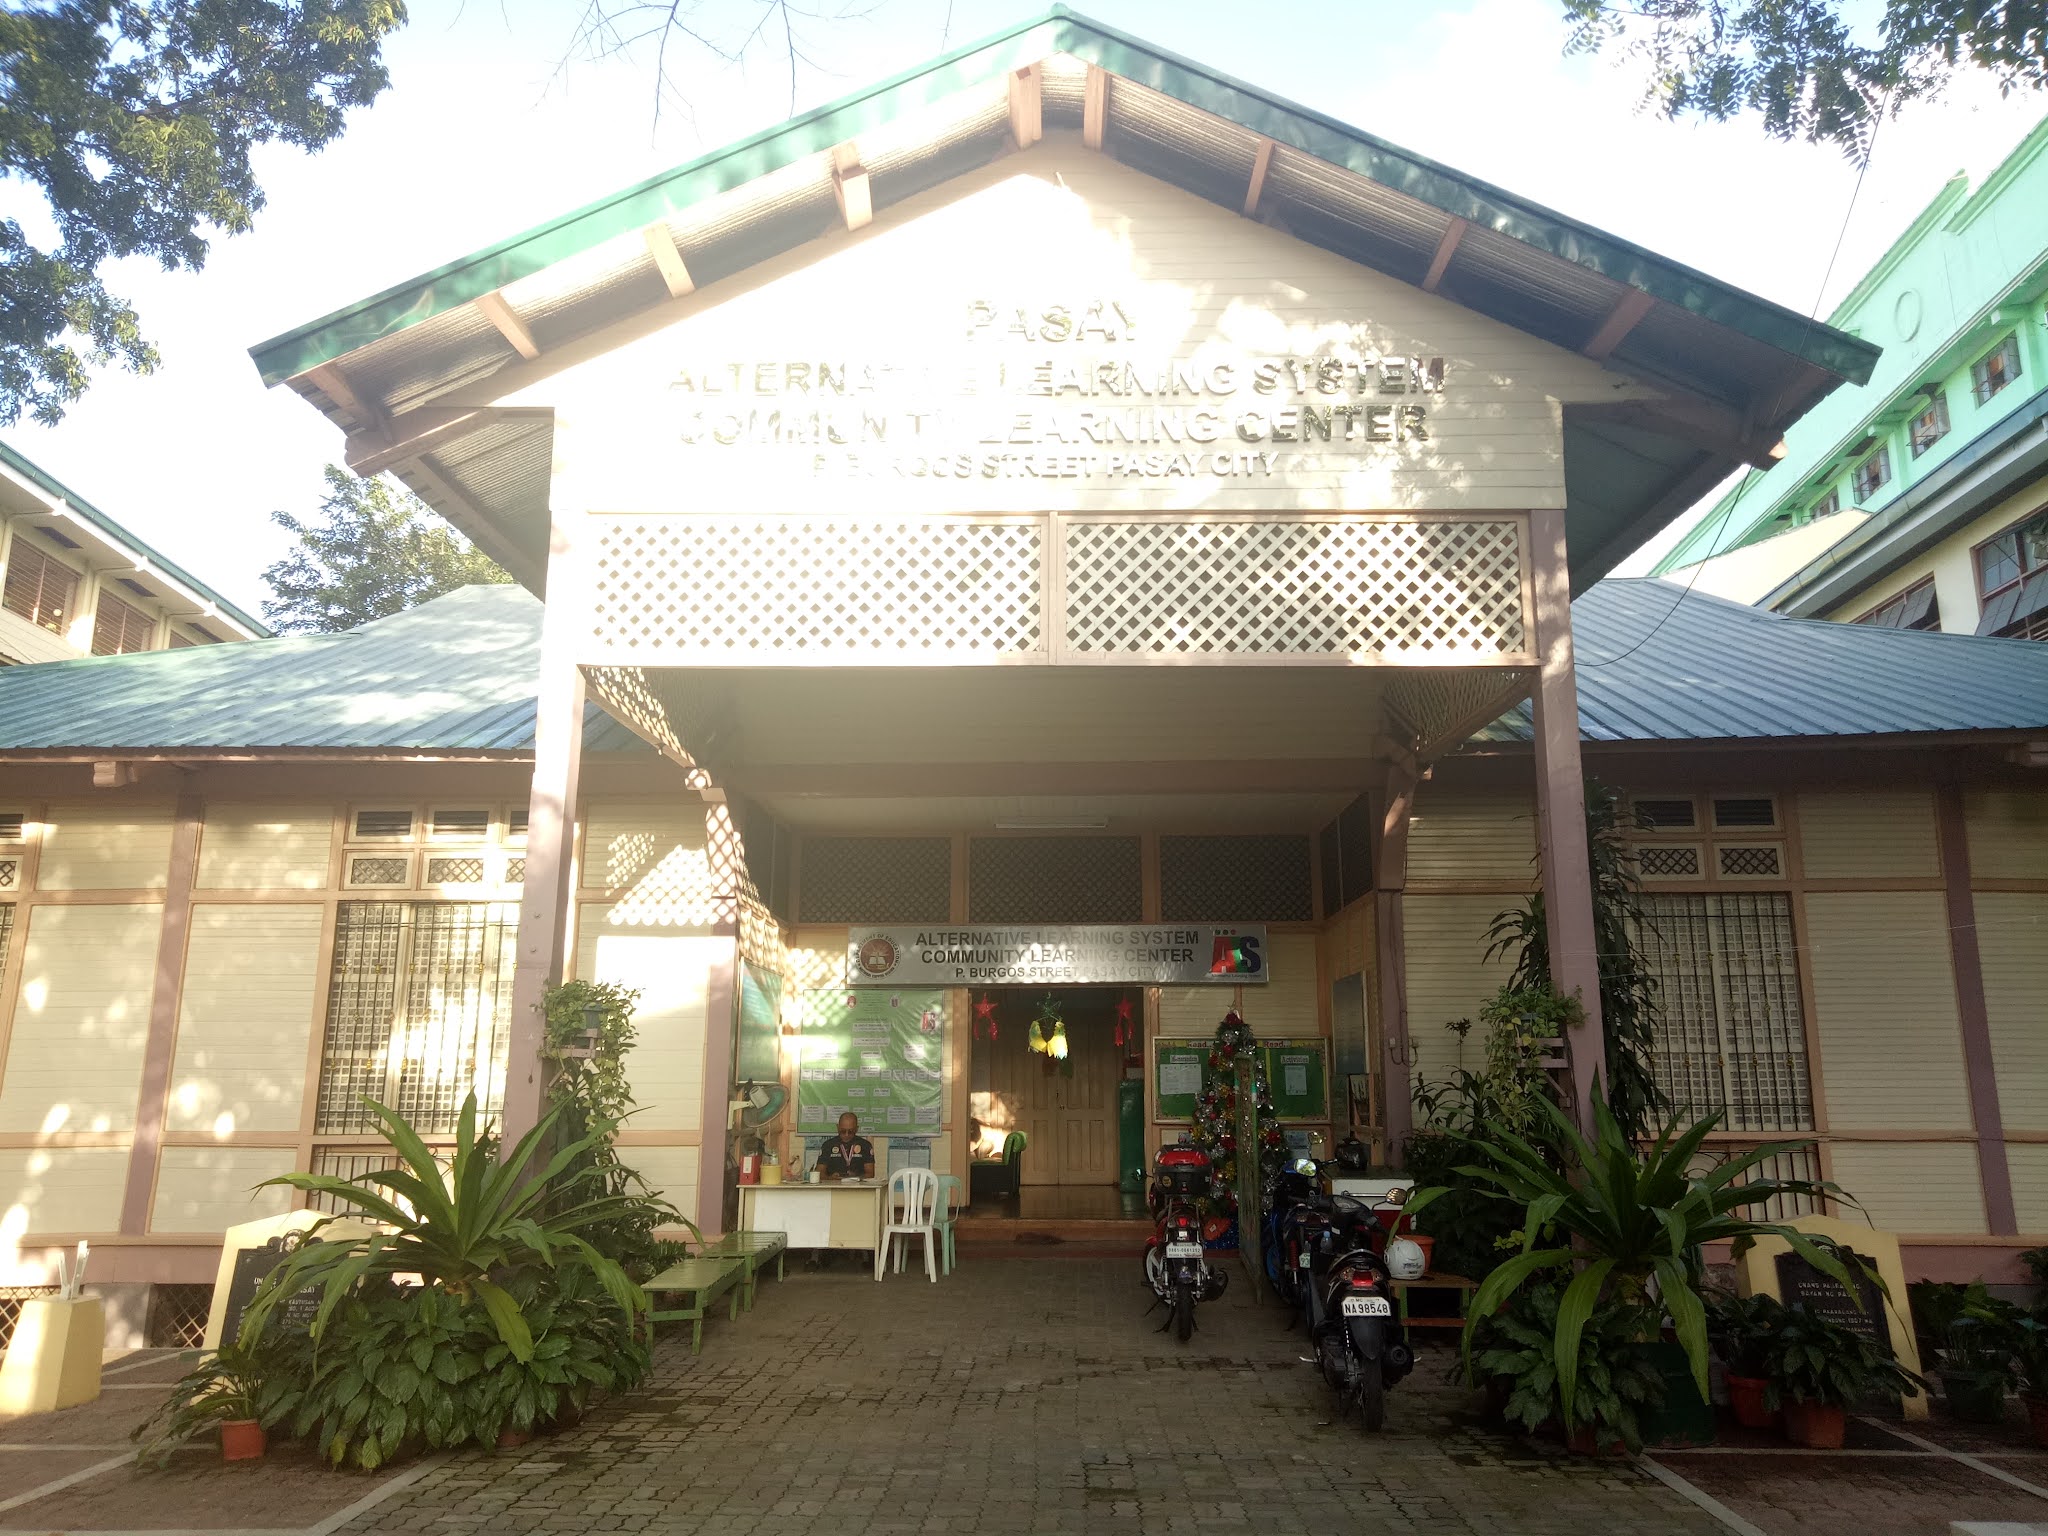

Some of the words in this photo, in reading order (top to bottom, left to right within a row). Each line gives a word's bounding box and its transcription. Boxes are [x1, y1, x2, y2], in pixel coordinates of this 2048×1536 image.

[965, 298, 1136, 342] PASAY
[1252, 356, 1446, 395] SYSTEM
[1235, 405, 1429, 442] CENTER
[979, 453, 1098, 479] STREET
[1106, 451, 1203, 478] PASAY
[1209, 450, 1280, 477] CITY
[915, 932, 1031, 946] ALTERNATIVE
[1036, 931, 1124, 945] LEARNING
[1129, 930, 1199, 944] SYSTEM
[921, 949, 1026, 963] COMMUNITY
[1030, 949, 1119, 962] LEARNING
[1123, 948, 1194, 962] CENTER
[955, 967, 966, 978] P.
[969, 967, 1026, 978] BURGOS
[1028, 966, 1079, 977] STREET
[1127, 966, 1158, 976] CITY
